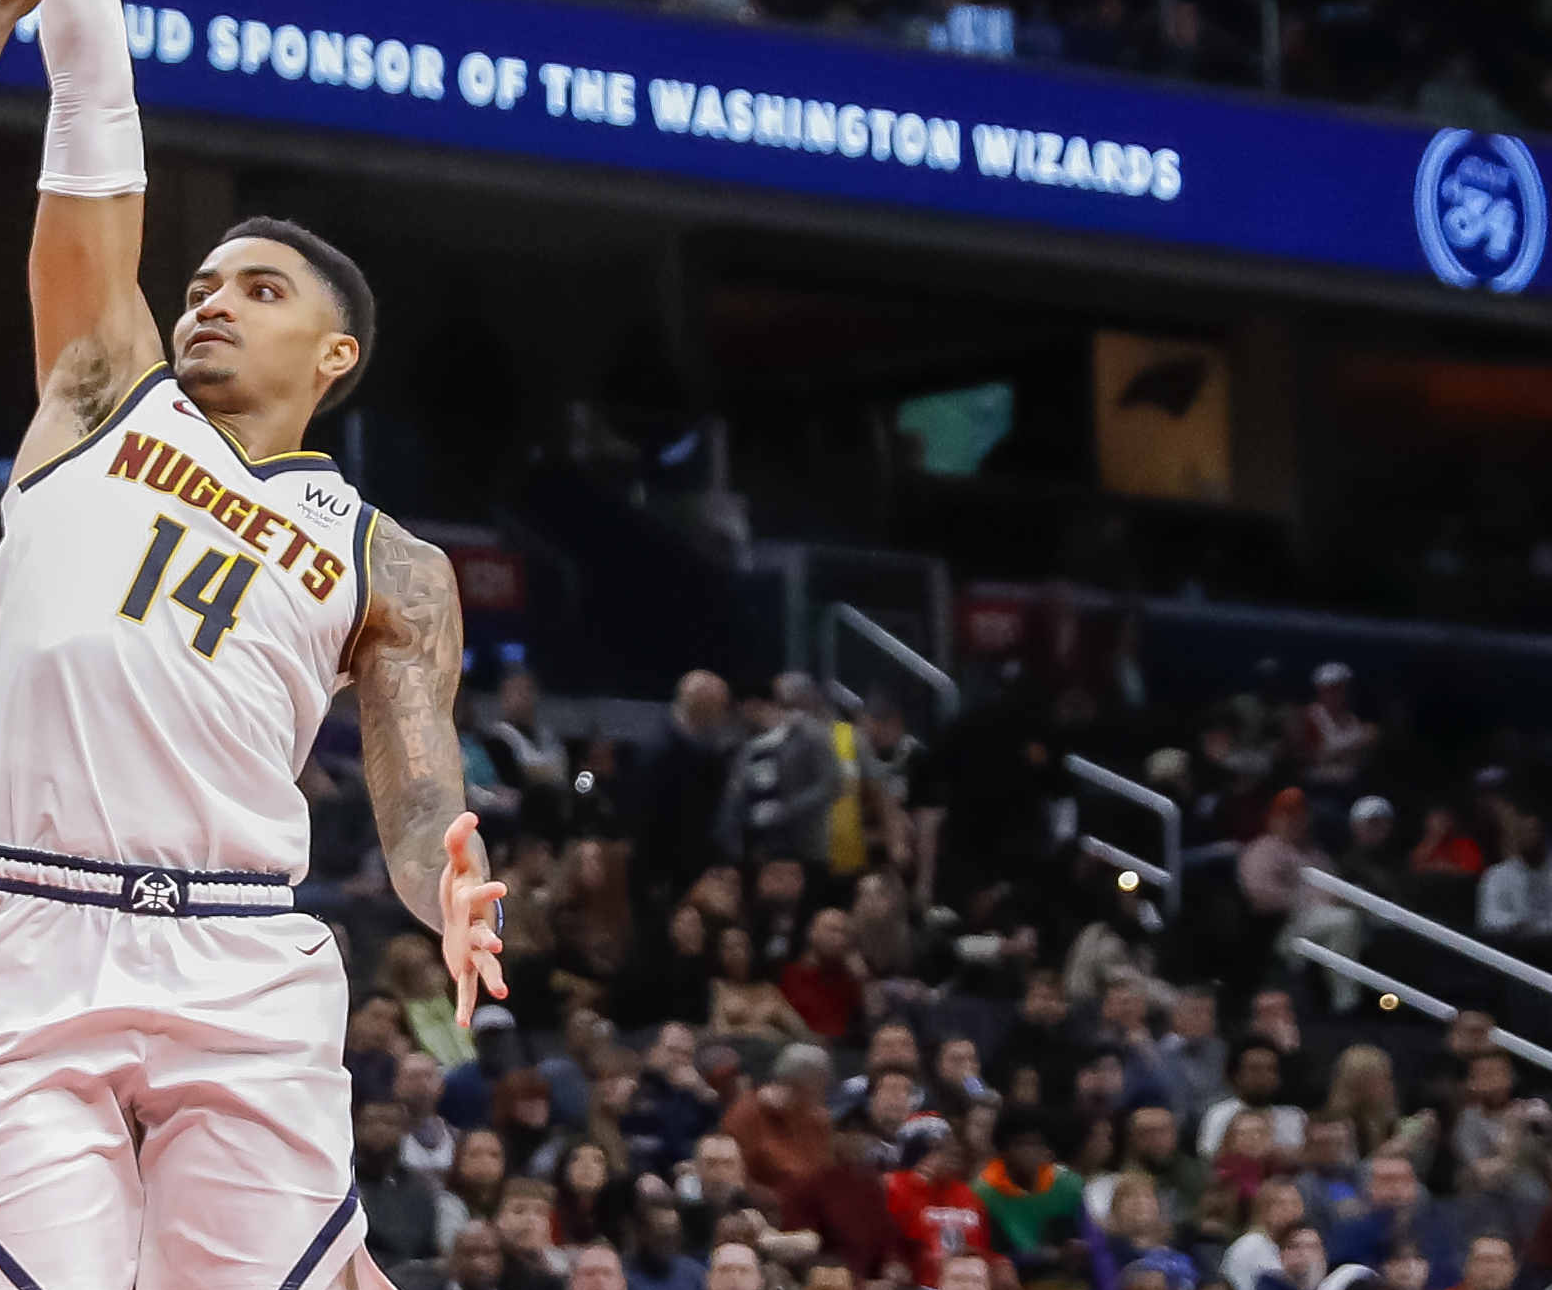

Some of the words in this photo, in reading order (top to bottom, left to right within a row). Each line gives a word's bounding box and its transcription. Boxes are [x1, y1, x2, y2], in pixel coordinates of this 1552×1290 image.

[207, 14, 446, 101] SPONSOR
[458, 51, 528, 111] OF
[540, 62, 637, 127] THE
[649, 76, 961, 172] WASHINGTON
[972, 123, 1183, 203] WIZARDS
[107, 430, 348, 604] NUGGETS
[304, 481, 352, 518] WU
[117, 512, 263, 661] 14
